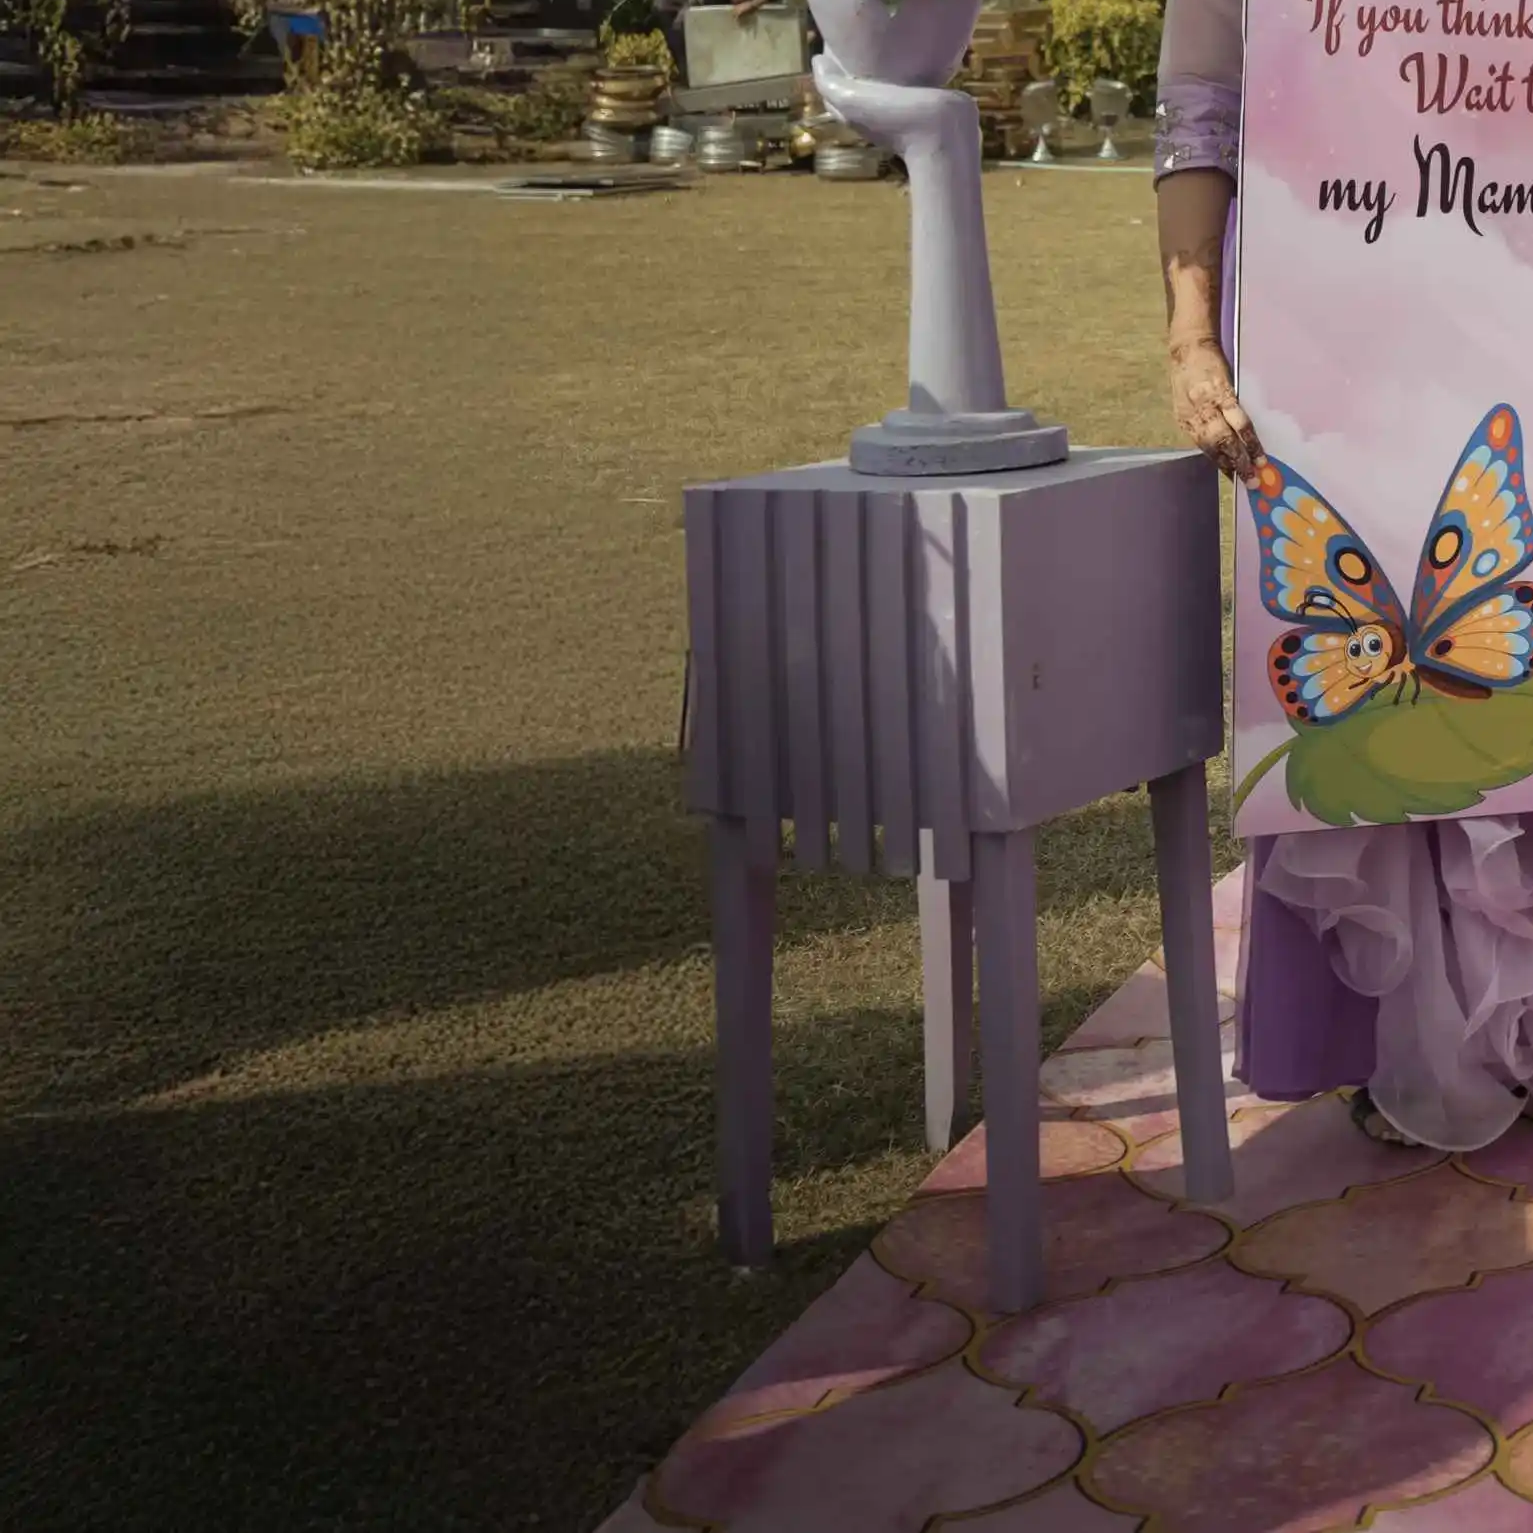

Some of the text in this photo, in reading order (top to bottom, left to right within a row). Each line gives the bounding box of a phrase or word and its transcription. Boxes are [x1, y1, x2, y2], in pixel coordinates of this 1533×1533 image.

[1357, 5, 1429, 57] you
[1400, 52, 1514, 114] Wait
[1319, 179, 1396, 244] my
